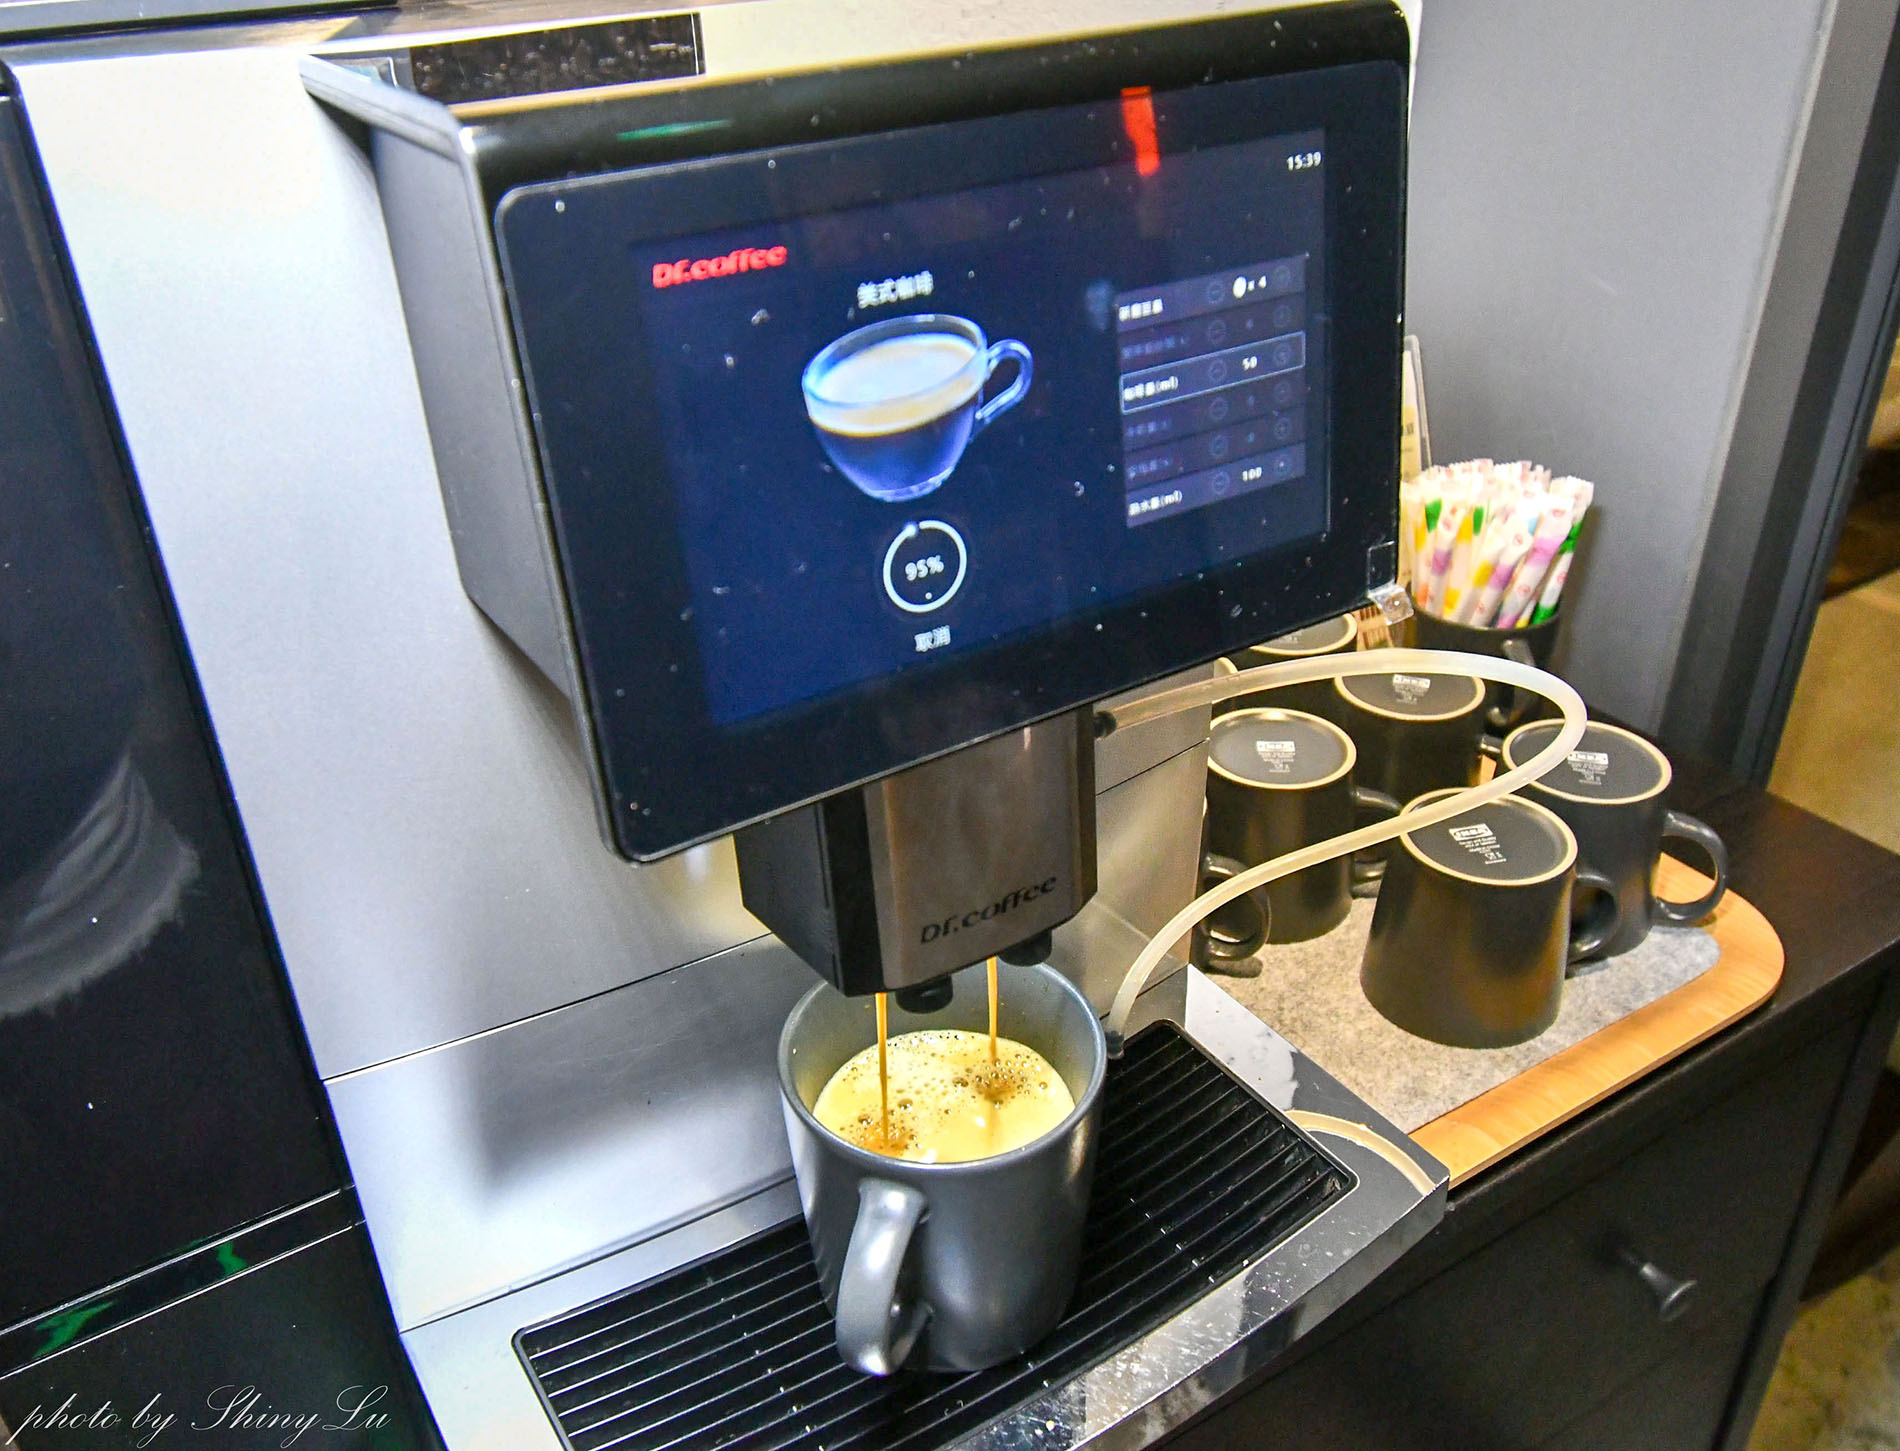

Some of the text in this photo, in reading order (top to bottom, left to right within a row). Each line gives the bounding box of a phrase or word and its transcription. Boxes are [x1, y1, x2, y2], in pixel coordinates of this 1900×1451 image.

[1286, 151, 1322, 171] 15:39
[904, 554, 945, 582] 95%
[914, 624, 952, 653] 取消
